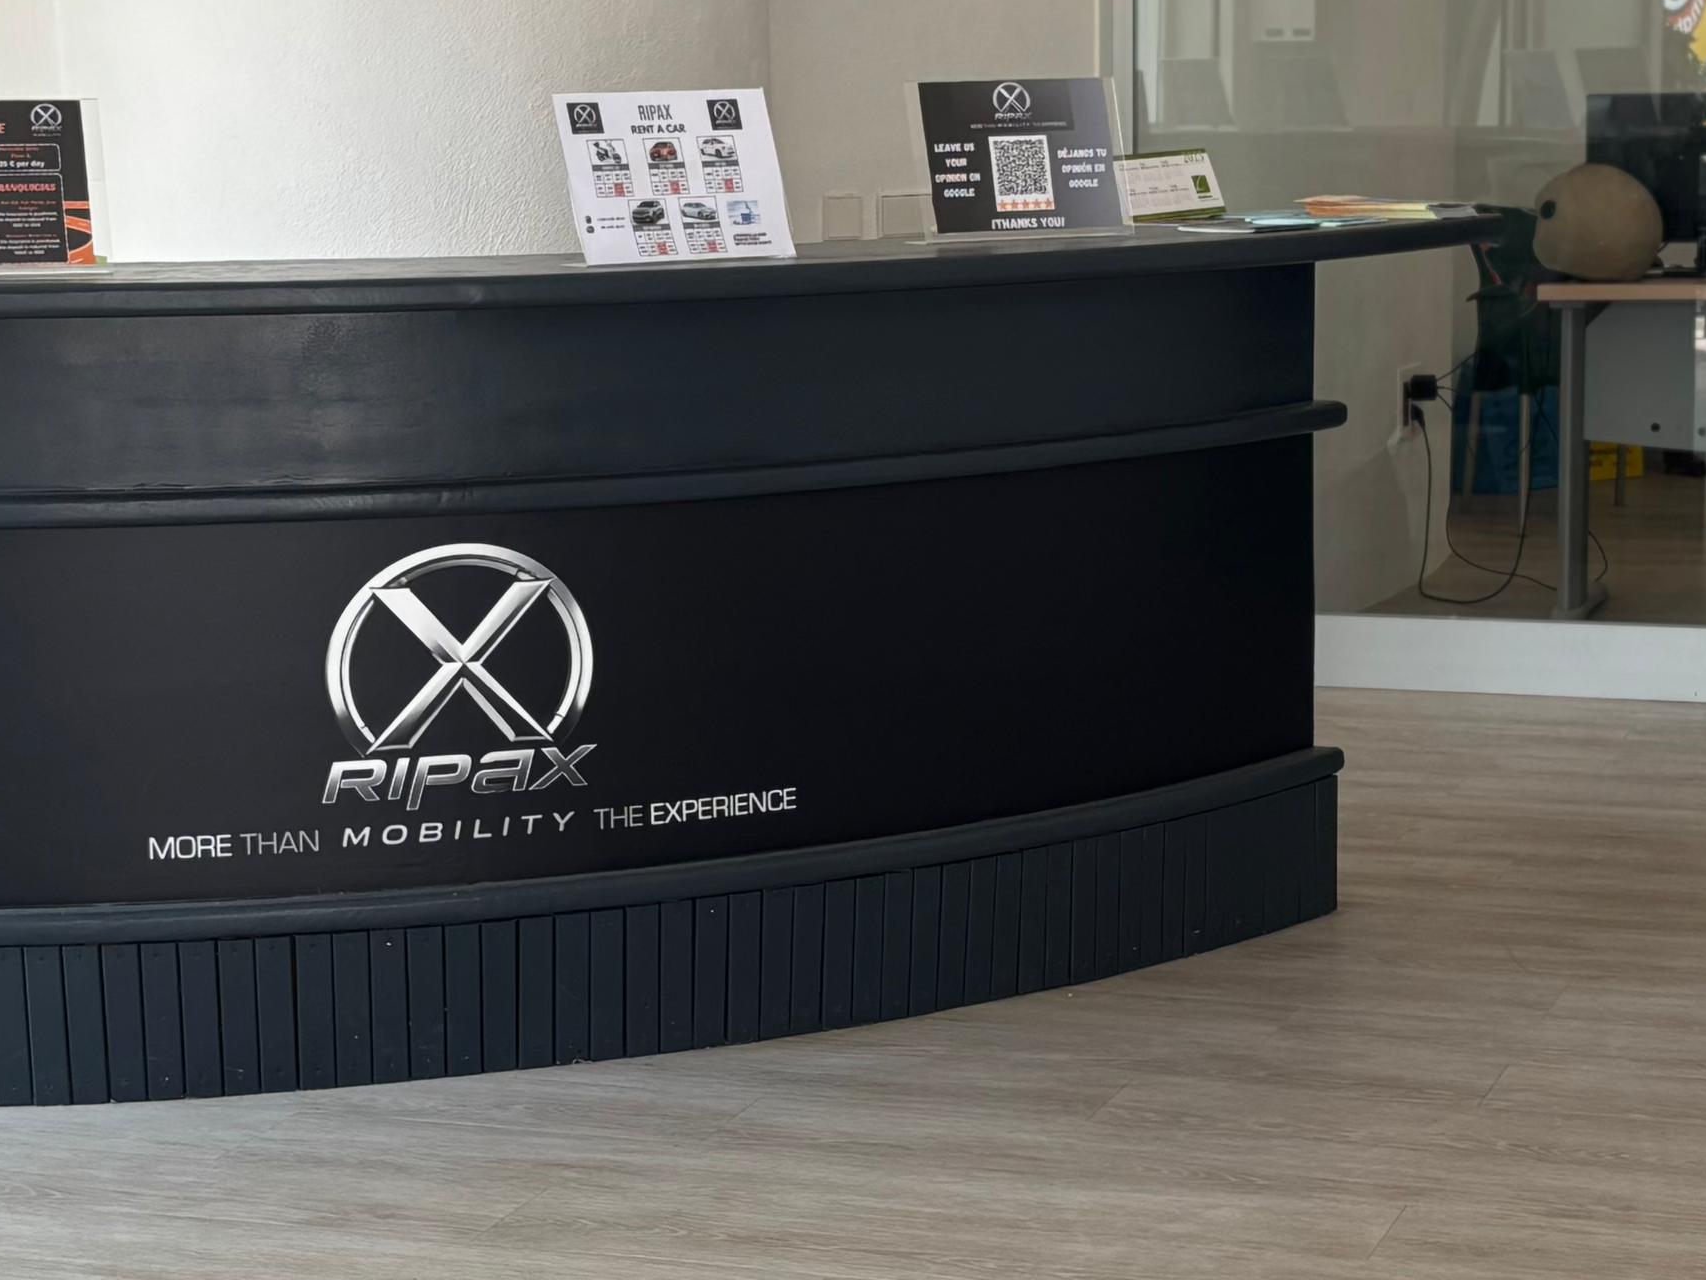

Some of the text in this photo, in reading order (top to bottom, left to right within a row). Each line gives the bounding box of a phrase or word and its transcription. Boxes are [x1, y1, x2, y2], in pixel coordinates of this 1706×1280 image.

[638, 104, 673, 121] RIPAX
[631, 124, 687, 134] RENT A CAR
[934, 142, 975, 153] LEAVE US
[1057, 147, 1107, 159] DÉJANOS TU
[945, 158, 967, 168] YOUR
[935, 173, 967, 183] OPINION
[1068, 179, 1098, 188] GOOGLE
[943, 188, 975, 198] GOOGLE
[149, 787, 796, 860] MORE THAN MOBILITY THE EXPERIENCE
